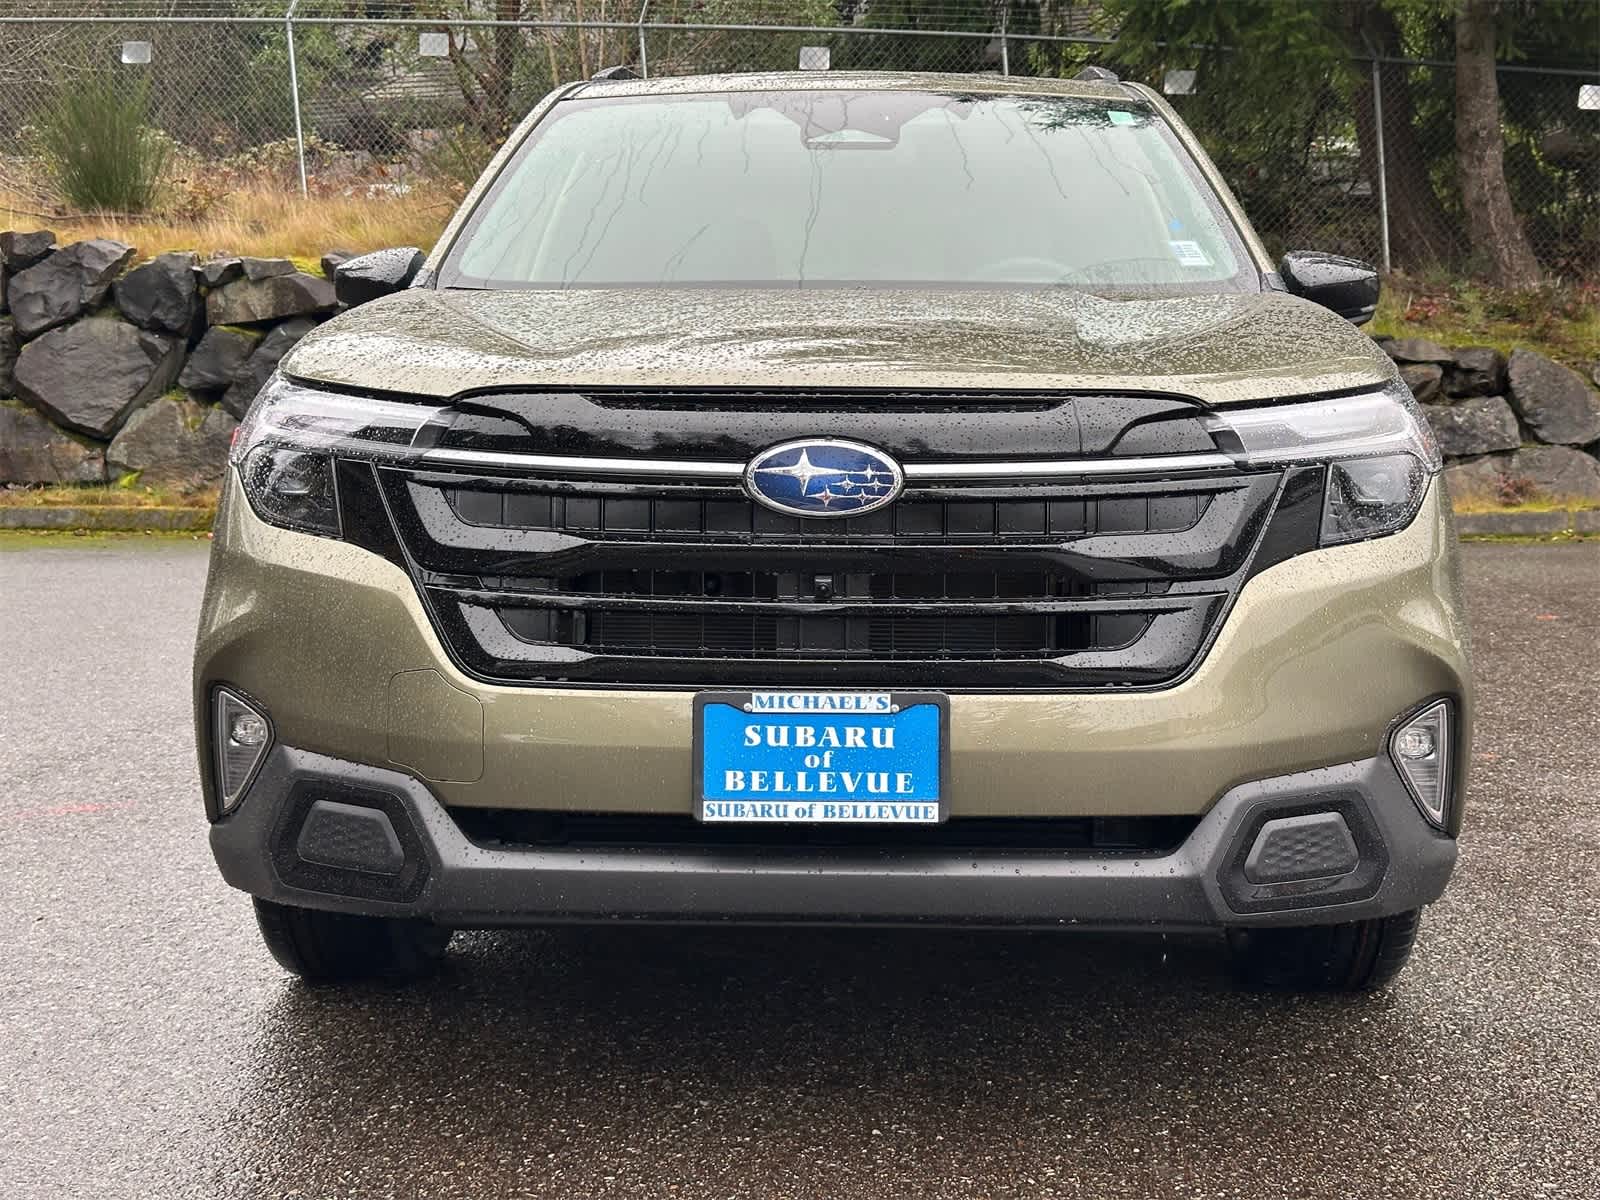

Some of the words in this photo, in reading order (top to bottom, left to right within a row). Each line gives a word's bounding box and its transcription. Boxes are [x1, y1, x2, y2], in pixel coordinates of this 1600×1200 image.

[754, 695, 889, 710] MICHAEL'S
[743, 724, 896, 749] SUBARU
[804, 750, 834, 769] of
[724, 770, 914, 794] BELLEVUE
[705, 802, 788, 818] SUBARU
[794, 803, 817, 819] of
[823, 804, 936, 820] BELLEVUE
